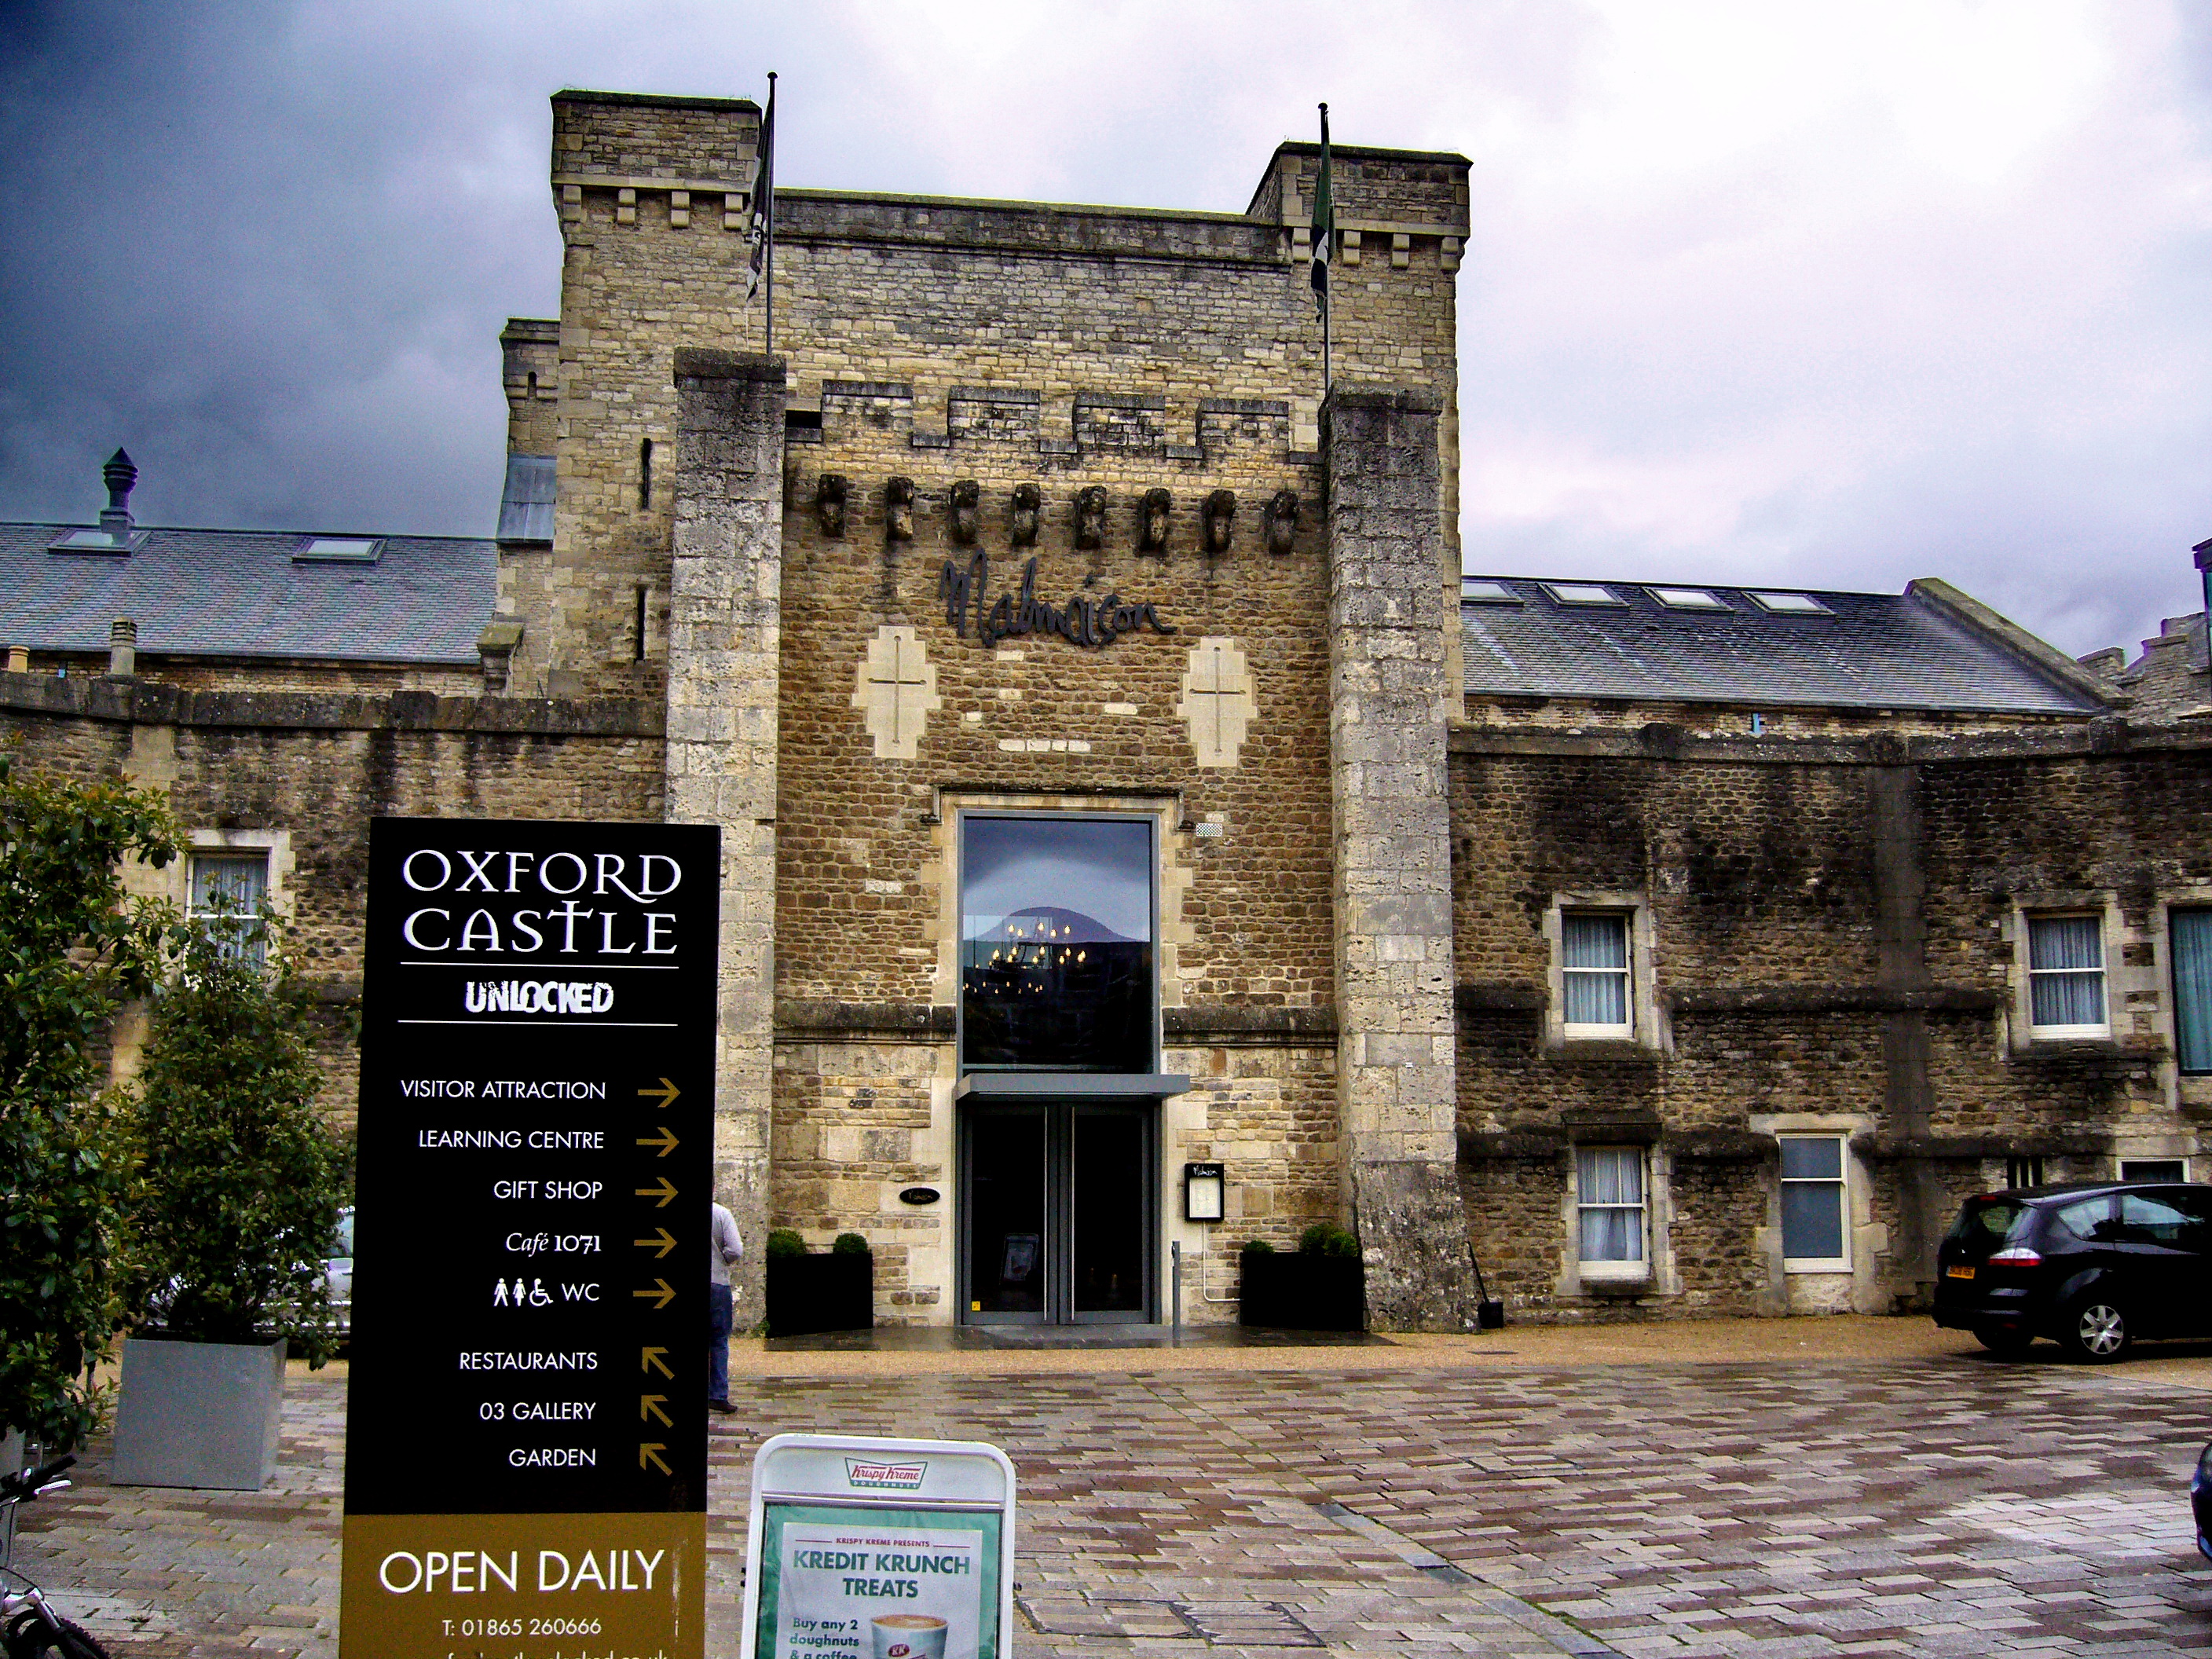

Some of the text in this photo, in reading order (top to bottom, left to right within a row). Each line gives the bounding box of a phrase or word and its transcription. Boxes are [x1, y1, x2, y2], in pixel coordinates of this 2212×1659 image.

[940, 548, 1177, 646] Malmaison
[402, 849, 682, 903] OXFORD
[403, 900, 678, 954] CASTLE
[465, 980, 614, 1014] UNLOCKED
[400, 1079, 606, 1100] VISITOR ATTRACTION
[419, 1130, 605, 1149] LEARNING CENTRE
[493, 1180, 603, 1199] GIFT SHOP
[505, 1232, 602, 1258] Café 1071
[561, 1283, 600, 1302] WC
[460, 1352, 598, 1370] RESTAURANTS
[479, 1401, 596, 1420] 03 GALLERY
[508, 1448, 596, 1467] GARDEN
[851, 1465, 921, 1481] Krispy Kreme
[379, 1549, 665, 1594] OPEN DAILY
[793, 1550, 970, 1574] KREDIT KRUNCH
[843, 1577, 919, 1598] TREATS
[441, 1618, 602, 1637] T: 01865 260666
[793, 1617, 859, 1632] Buy any 2
[789, 1633, 859, 1648] doughnuts
